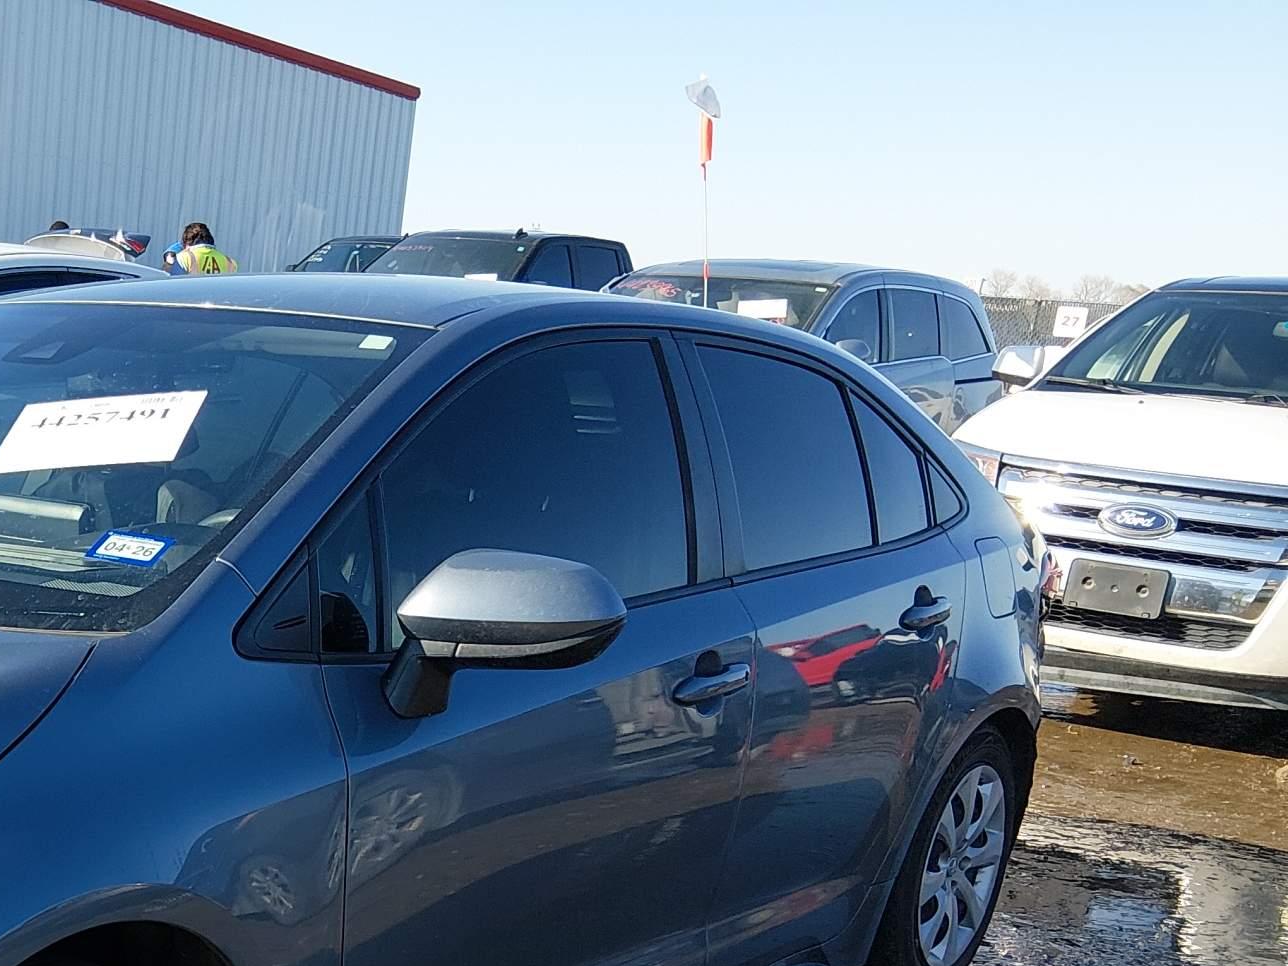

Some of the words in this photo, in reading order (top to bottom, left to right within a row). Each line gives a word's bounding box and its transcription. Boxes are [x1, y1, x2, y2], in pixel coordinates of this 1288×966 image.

[1061, 315, 1081, 327] 27
[31, 408, 171, 429] 44257491
[1115, 509, 1157, 528] Ford
